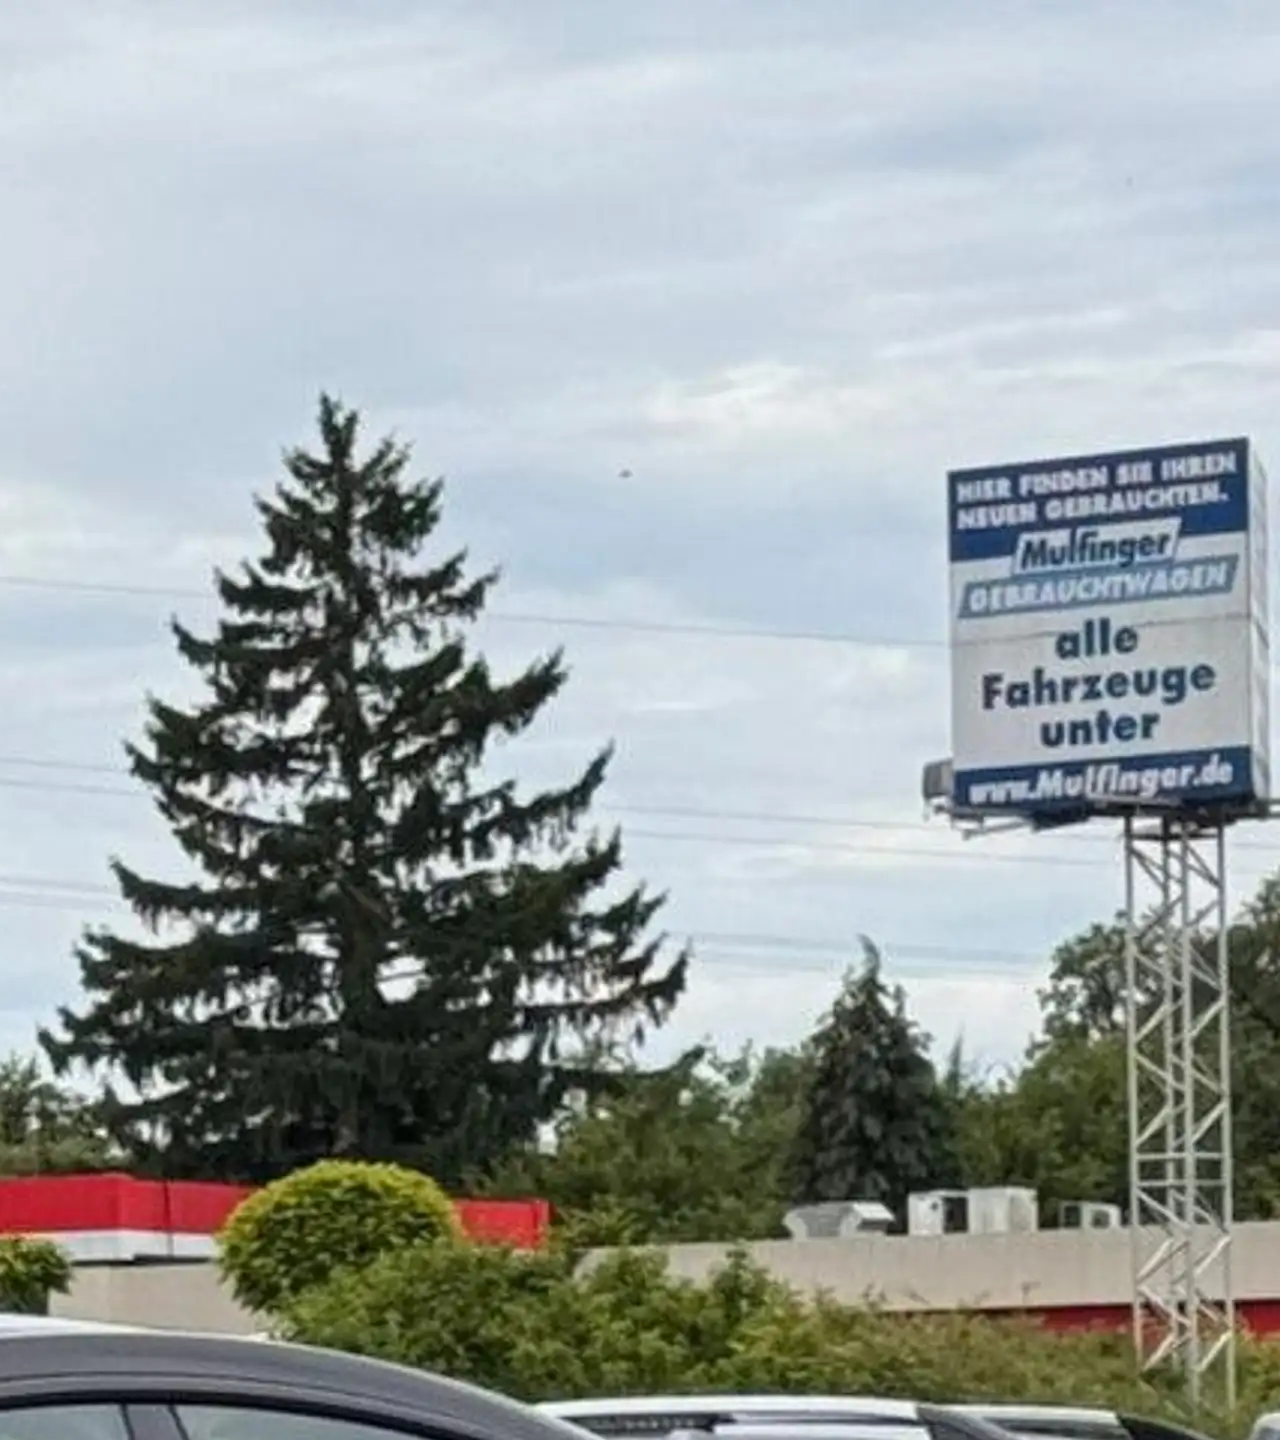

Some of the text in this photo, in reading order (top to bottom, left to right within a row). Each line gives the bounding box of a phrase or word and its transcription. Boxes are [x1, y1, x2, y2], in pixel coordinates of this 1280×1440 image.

[956, 451, 1237, 503] HIER FINDEN SIE IHREN
[956, 500, 1037, 530] NEUEN
[1018, 525, 1171, 570] Mulfinger
[969, 562, 1228, 612] GEBRAUCHTWAGEN
[1054, 617, 1139, 660] alle
[981, 662, 1217, 711] Fahrzeuge
[1040, 710, 1162, 749] unter
